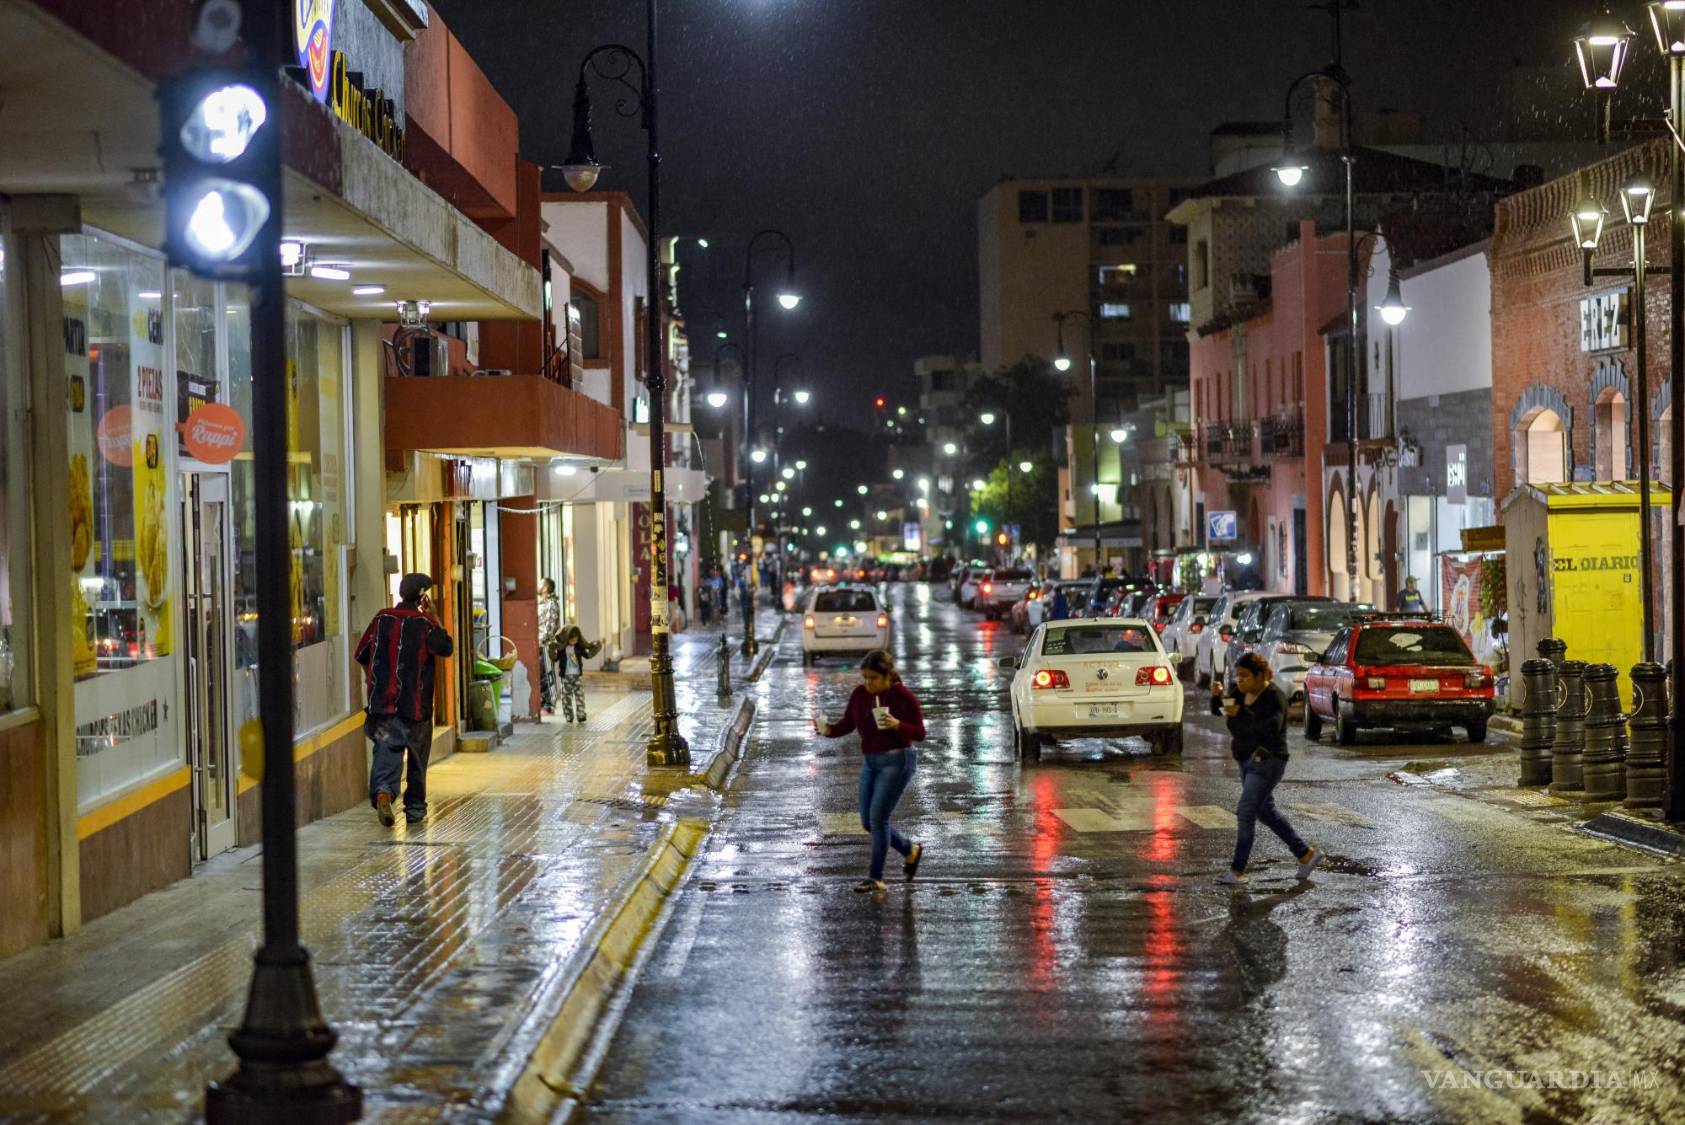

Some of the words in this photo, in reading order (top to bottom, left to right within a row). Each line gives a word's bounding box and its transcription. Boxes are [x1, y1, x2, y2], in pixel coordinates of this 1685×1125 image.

[142, 366, 163, 401] PIEZAS
[192, 426, 238, 449] Rappi
[1553, 558, 1577, 571] EL
